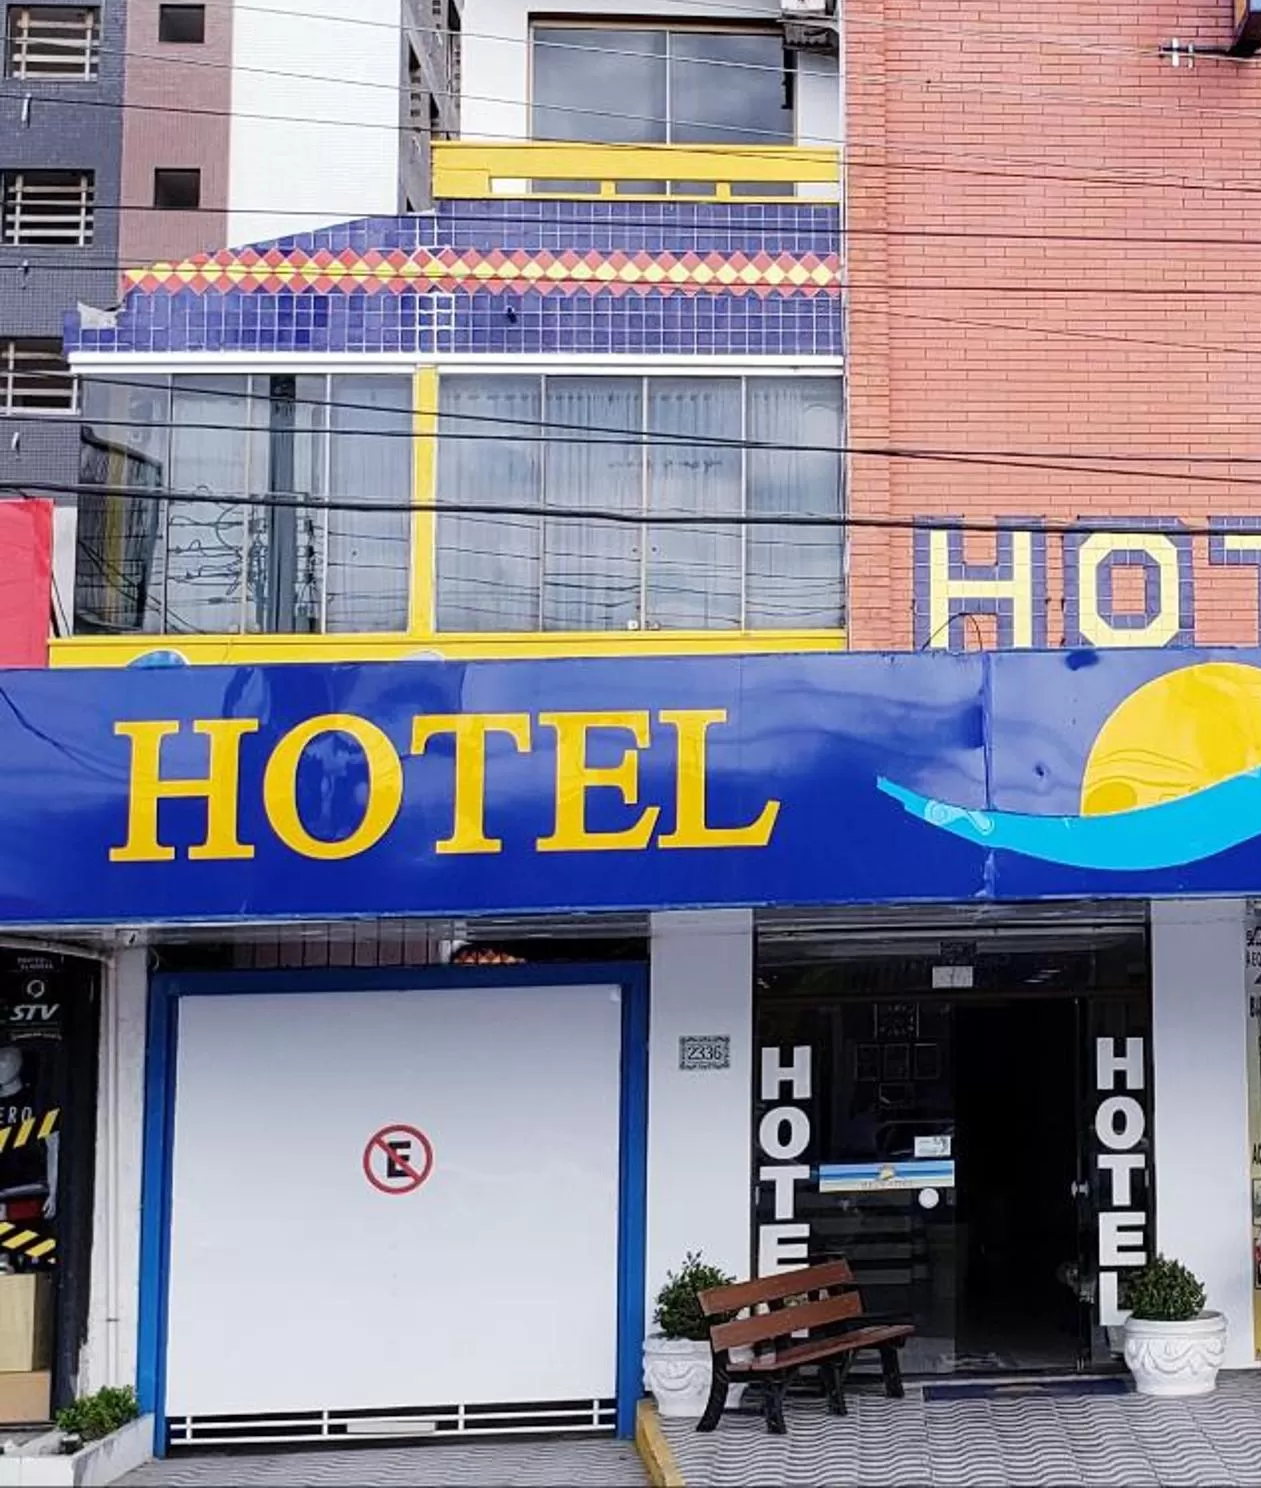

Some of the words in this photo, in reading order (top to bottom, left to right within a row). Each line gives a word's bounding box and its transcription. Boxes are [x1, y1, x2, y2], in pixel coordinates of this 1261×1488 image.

[109, 709, 781, 862] HOTEL
[9, 1002, 61, 1021] STV
[757, 1044, 812, 1338] HOTE
[1095, 1036, 1147, 1328] HOTEL
